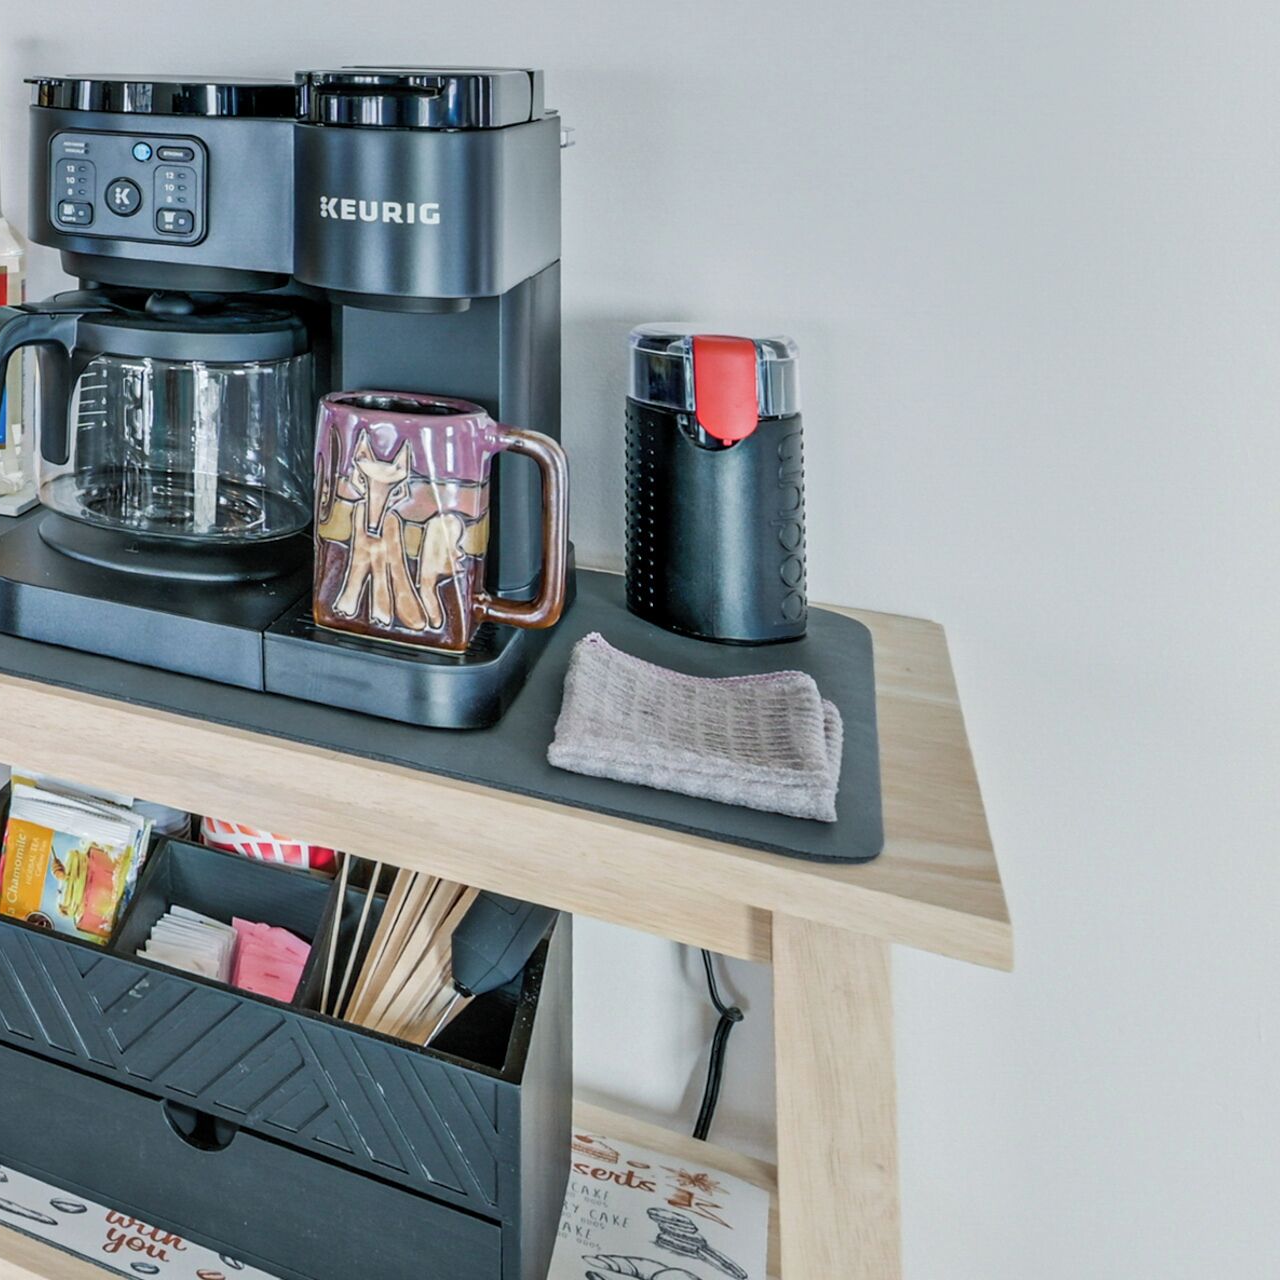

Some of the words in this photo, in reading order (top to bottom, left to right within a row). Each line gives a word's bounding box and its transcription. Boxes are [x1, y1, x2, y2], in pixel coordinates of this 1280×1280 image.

[66, 176, 75, 184] 10
[164, 183, 175, 191] 10
[165, 171, 174, 179] 12
[320, 196, 440, 225] KEURIG
[771, 431, 804, 627] bodum
[6, 832, 27, 903] Chamomile
[572, 1163, 657, 1193] serts
[102, 1227, 170, 1263] you
[562, 1222, 592, 1240] AKE
